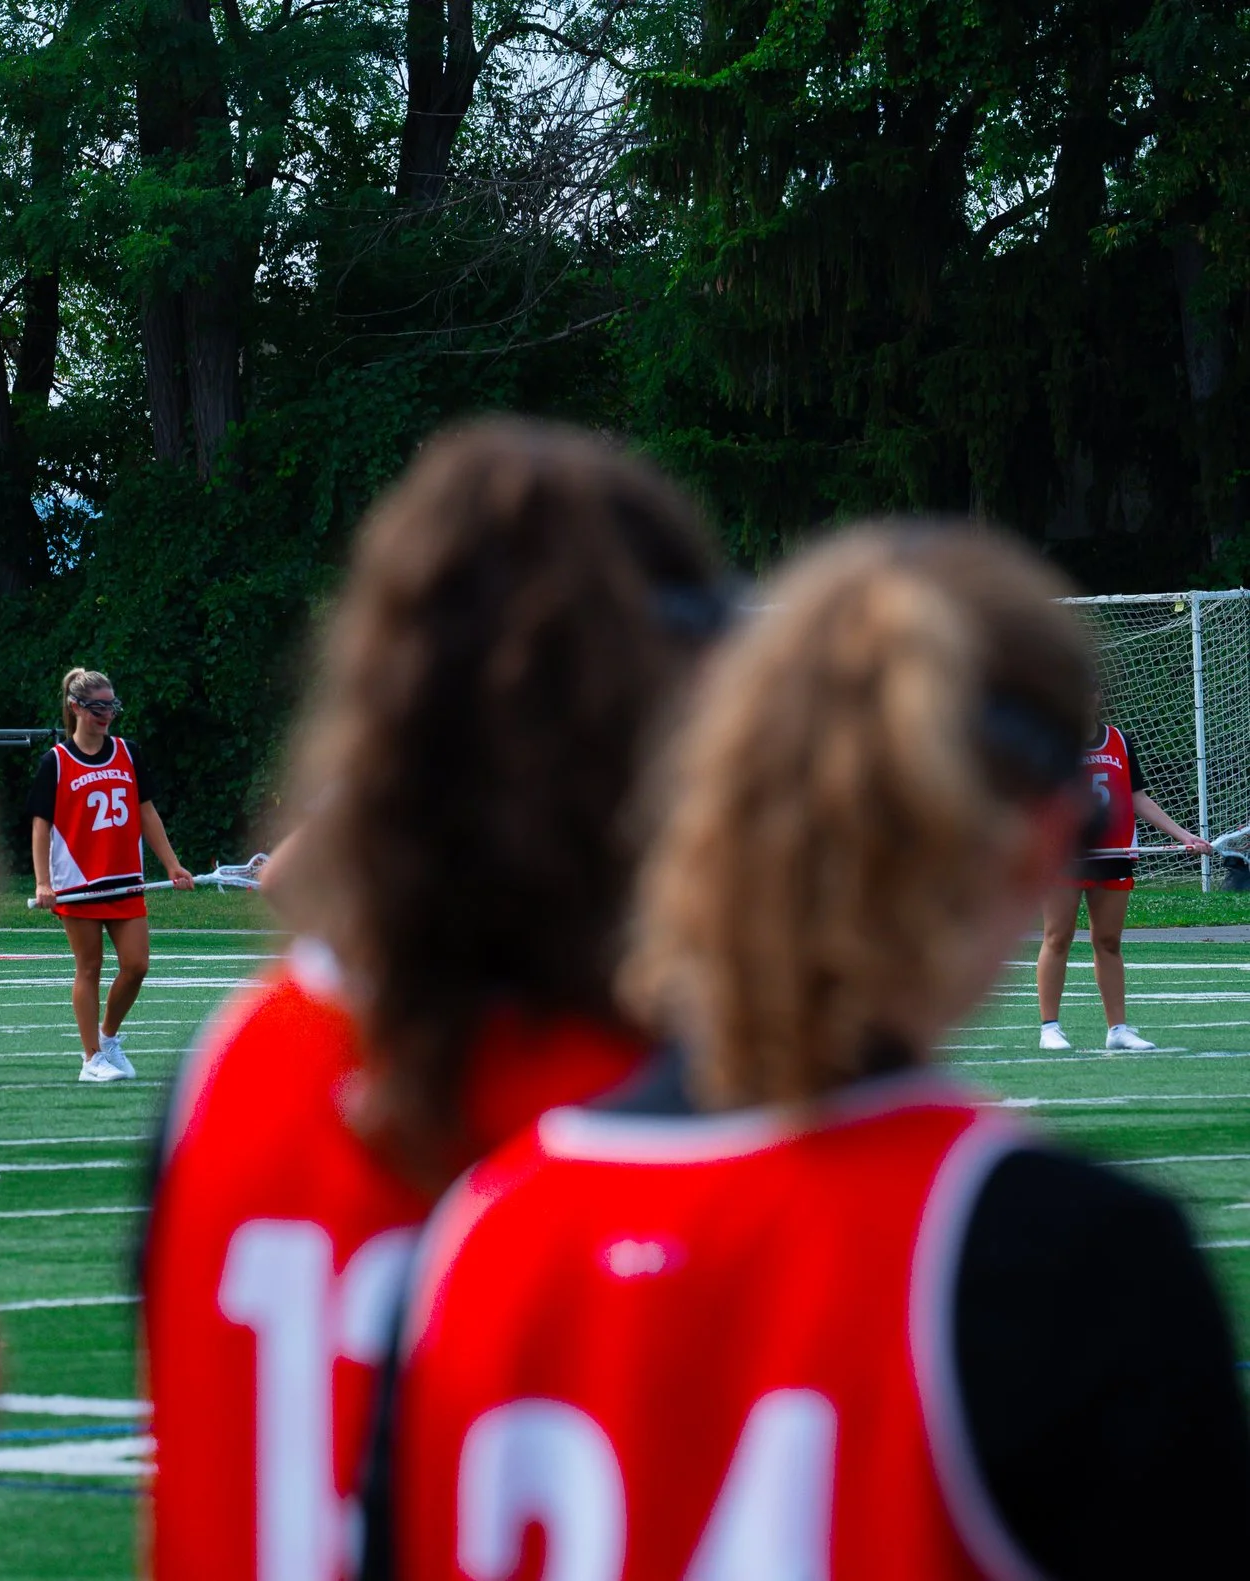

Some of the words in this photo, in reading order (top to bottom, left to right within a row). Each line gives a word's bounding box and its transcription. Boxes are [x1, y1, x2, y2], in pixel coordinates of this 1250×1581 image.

[1082, 754, 1123, 770] RNELL
[70, 769, 133, 791] CORNELL
[87, 787, 129, 832] 25
[456, 1387, 838, 1581] 24
